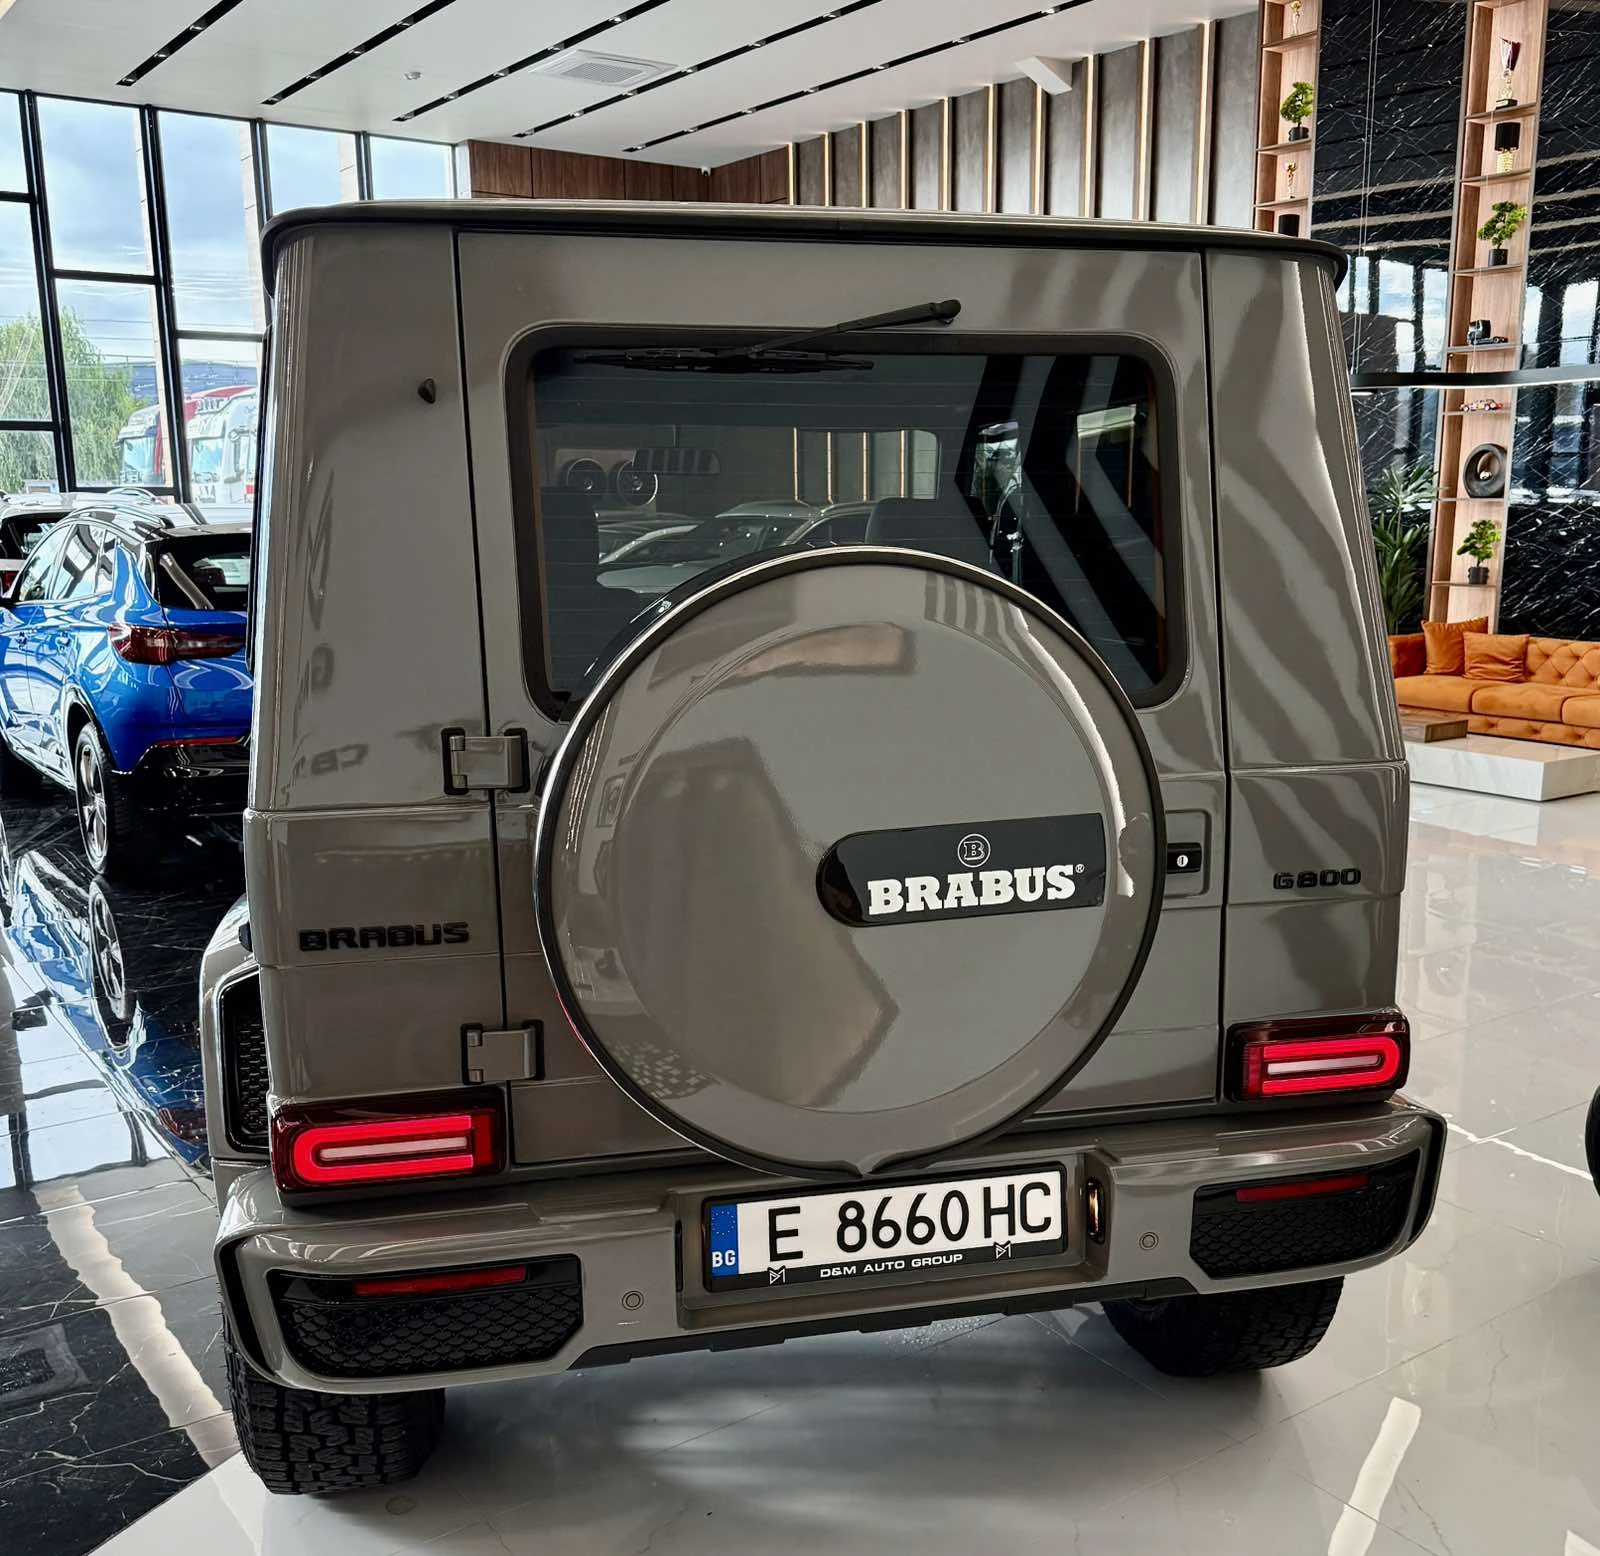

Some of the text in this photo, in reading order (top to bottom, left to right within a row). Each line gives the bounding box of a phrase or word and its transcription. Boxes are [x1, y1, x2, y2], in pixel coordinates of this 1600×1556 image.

[1273, 868, 1362, 889] G800
[299, 921, 470, 952] BRABUS
[767, 1181, 1052, 1263] E 8660 HC
[711, 1250, 736, 1268] BG
[819, 1253, 963, 1279] D&M AUTO GROUP
